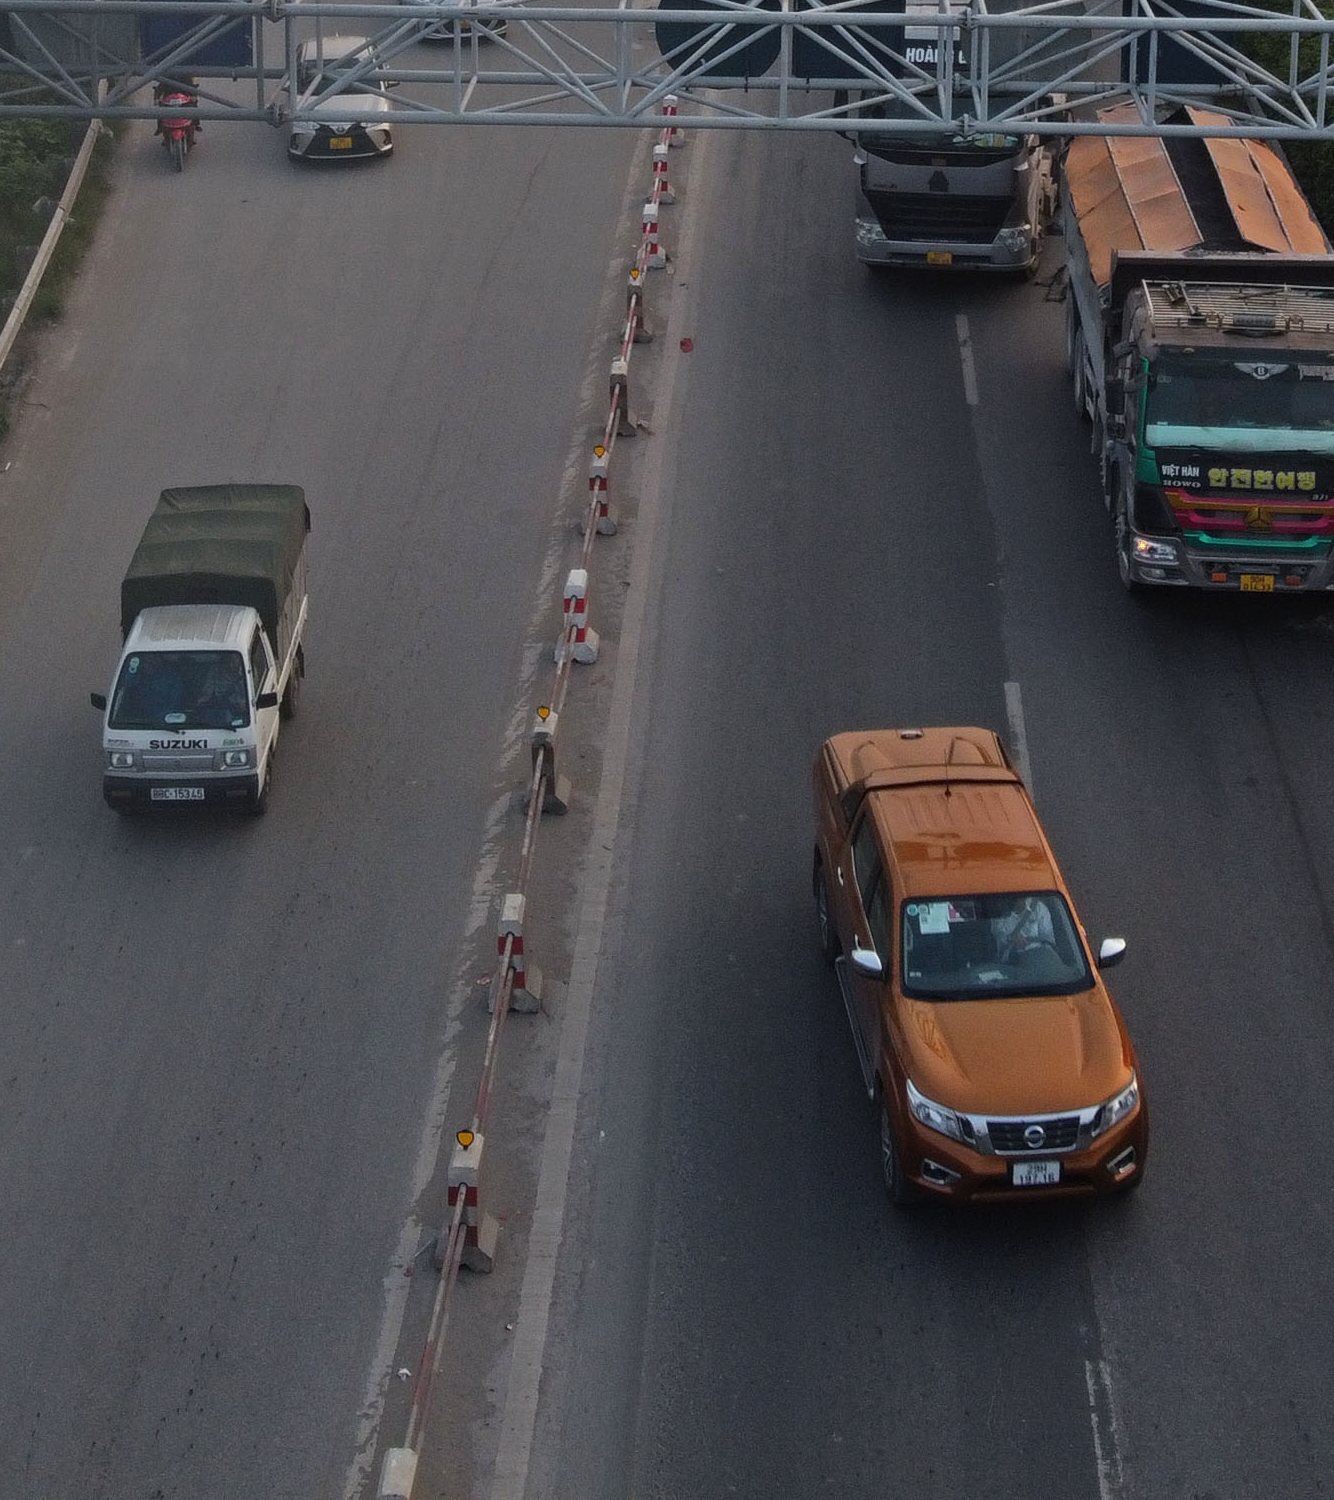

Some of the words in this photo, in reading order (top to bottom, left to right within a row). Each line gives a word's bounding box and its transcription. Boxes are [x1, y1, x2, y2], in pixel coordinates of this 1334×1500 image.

[1161, 464, 1180, 477] VIỆT
[1181, 464, 1200, 477] HÀN
[149, 739, 208, 750] SUZUKI
